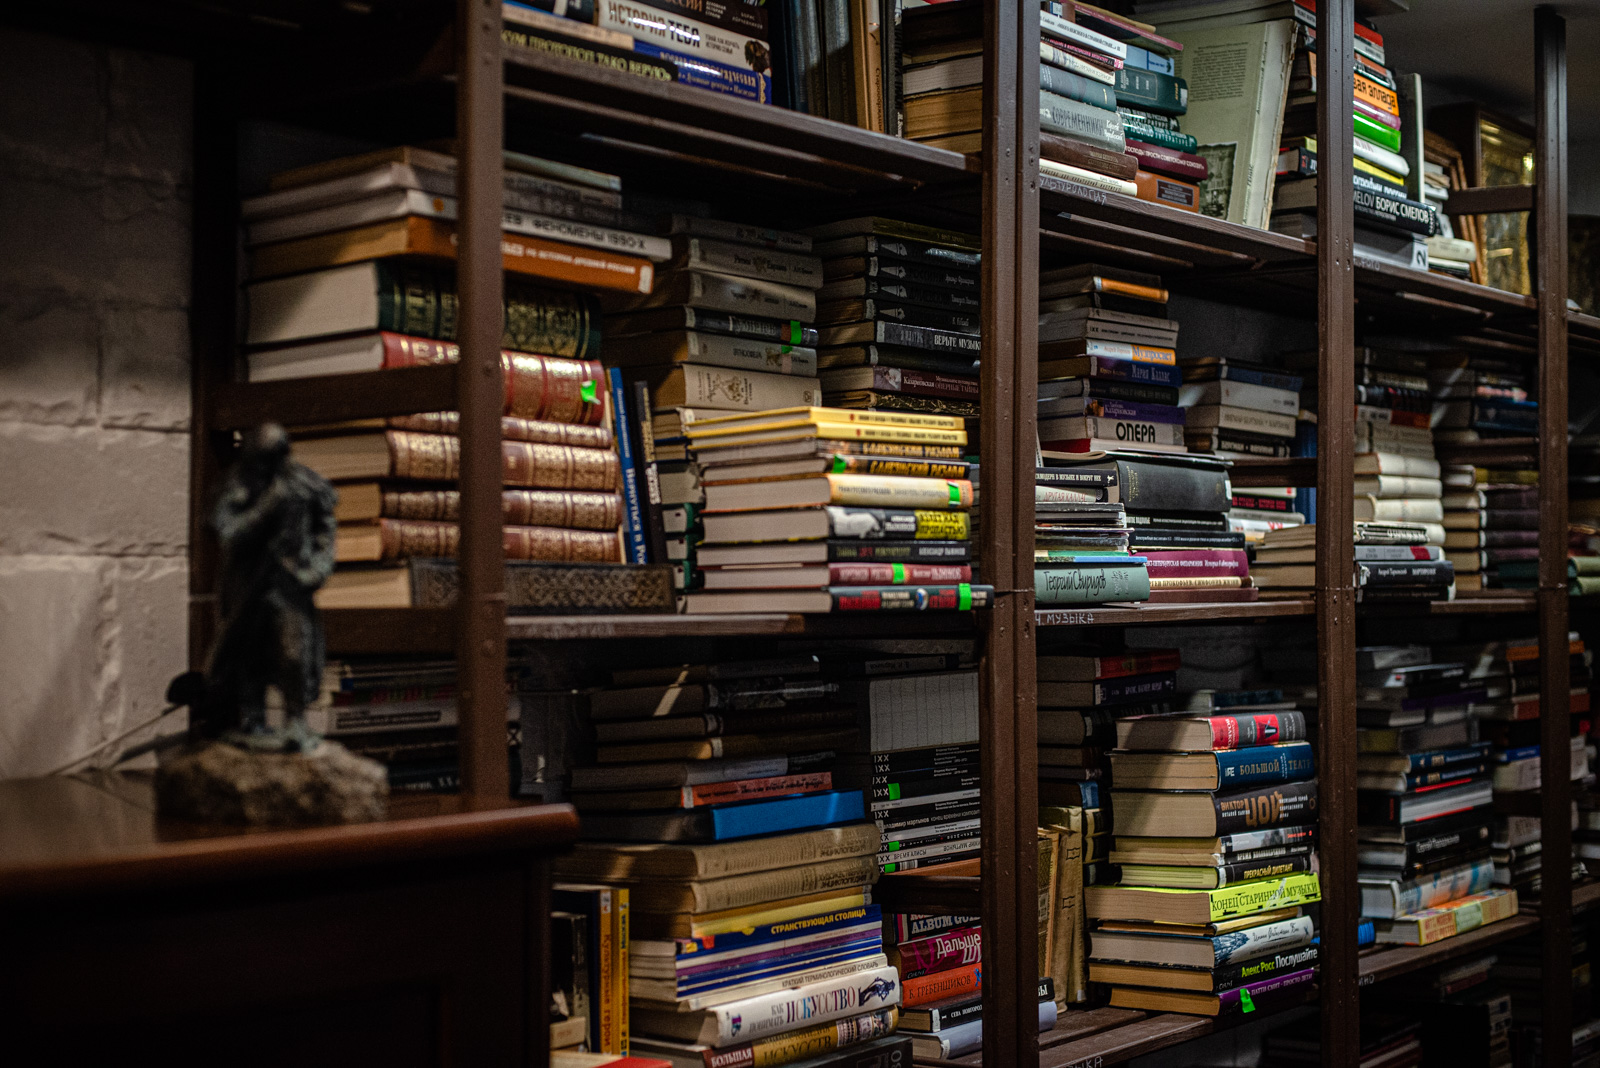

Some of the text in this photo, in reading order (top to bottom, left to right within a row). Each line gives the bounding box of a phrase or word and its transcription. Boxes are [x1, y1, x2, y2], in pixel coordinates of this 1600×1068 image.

[608, 3, 701, 48] ИСТОРИЯ ТЕБЯ
[529, 35, 627, 72] ПРОТОПОП ТАКО
[1376, 195, 1429, 224] БОРИС СМЕЛОВ
[1416, 249, 1427, 267] 2
[934, 334, 957, 347] ВЕРЬТЕ
[1132, 346, 1174, 363] Музпросвет
[1115, 421, 1156, 443] ОПЕРА
[1060, 473, 1076, 482] МУЗЫКЕ
[1044, 571, 1073, 599] Георгий
[1073, 569, 1107, 598] Свиридов
[1047, 611, 1095, 625] МУЗЫКА
[1238, 758, 1311, 776] БОЛЬШОЙ ТЕАТР
[1220, 790, 1284, 828] ВИКТОР ЦОЙ
[894, 851, 909, 861] ВРЕМЯ
[1243, 863, 1294, 880] ПРЕКРАСНЫЙ ДИЛЕТАНТ
[1212, 880, 1318, 912] КОНЕЦ СТАРИННОЙ МУЗЫКИ
[770, 908, 867, 934] СТРАНСТВУЮЩАЯ СТОЛИЦА
[911, 916, 953, 935] ALBUM
[936, 933, 981, 959] Дальше
[782, 960, 879, 987] КРАТКИЙ ТЕРМИНОЛОГИЧЕСКИЙ СЛОВАРЬ
[1241, 949, 1318, 979] Алекс Росс Послушайте
[602, 934, 611, 1047] Культурные герои
[909, 975, 971, 999] Б. ГРЕБЕНЩИКОВ
[1251, 986, 1265, 996] ПАТТИ
[1267, 982, 1281, 992] СМИТ
[1283, 978, 1299, 989] ПРОСТО
[771, 986, 856, 1024] КАК ИСКУССТВО
[951, 1011, 961, 1019] СЕВА
[749, 1015, 785, 1034] ПОНИМАТЬ
[711, 1047, 753, 1068] БОЛЬШАЯ
[762, 1036, 833, 1067] ИСКУССТВ
